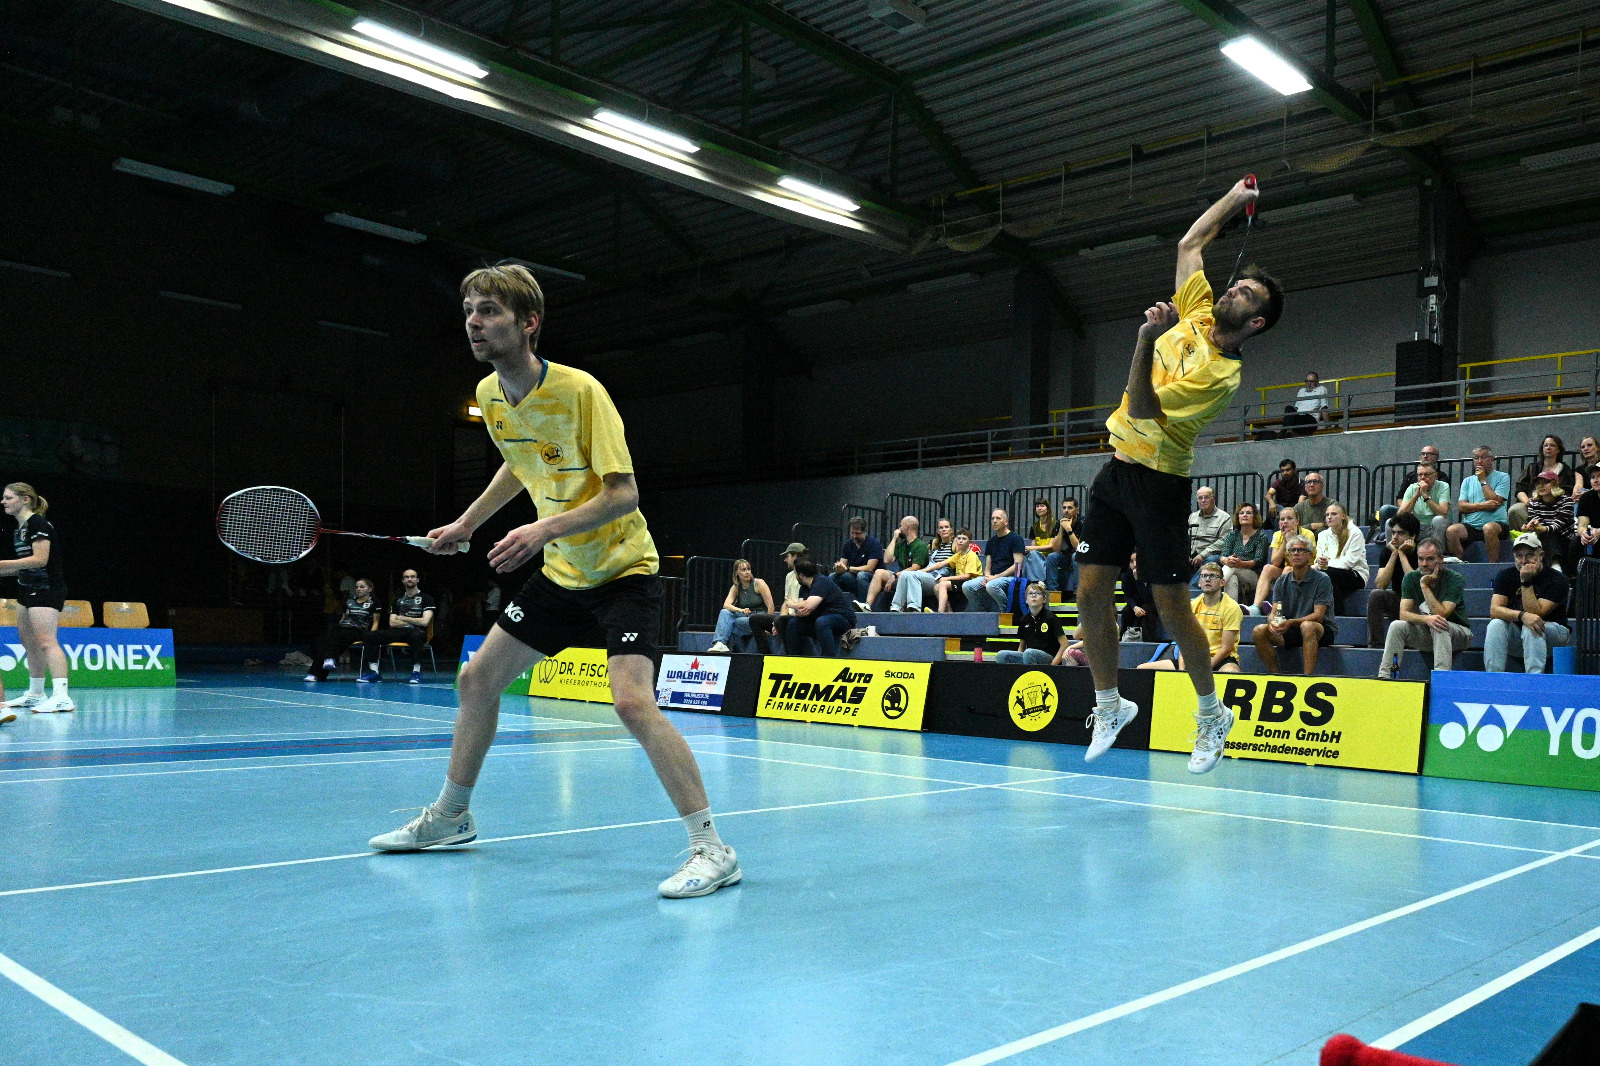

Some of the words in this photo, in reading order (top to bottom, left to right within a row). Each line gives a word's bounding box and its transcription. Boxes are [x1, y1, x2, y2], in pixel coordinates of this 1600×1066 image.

[63, 643, 164, 671] YONEX
[559, 661, 576, 676] DR.
[666, 670, 719, 682] WALBRÜCK
[884, 670, 915, 680] ŠKODA
[768, 673, 868, 705] THOMAS
[764, 699, 860, 717] FIRMENGRUPPE
[1223, 678, 1338, 727] RBS
[1253, 725, 1291, 740] Bonn
[1295, 728, 1342, 744] GmbH
[1224, 740, 1340, 759] asserschadenservice
